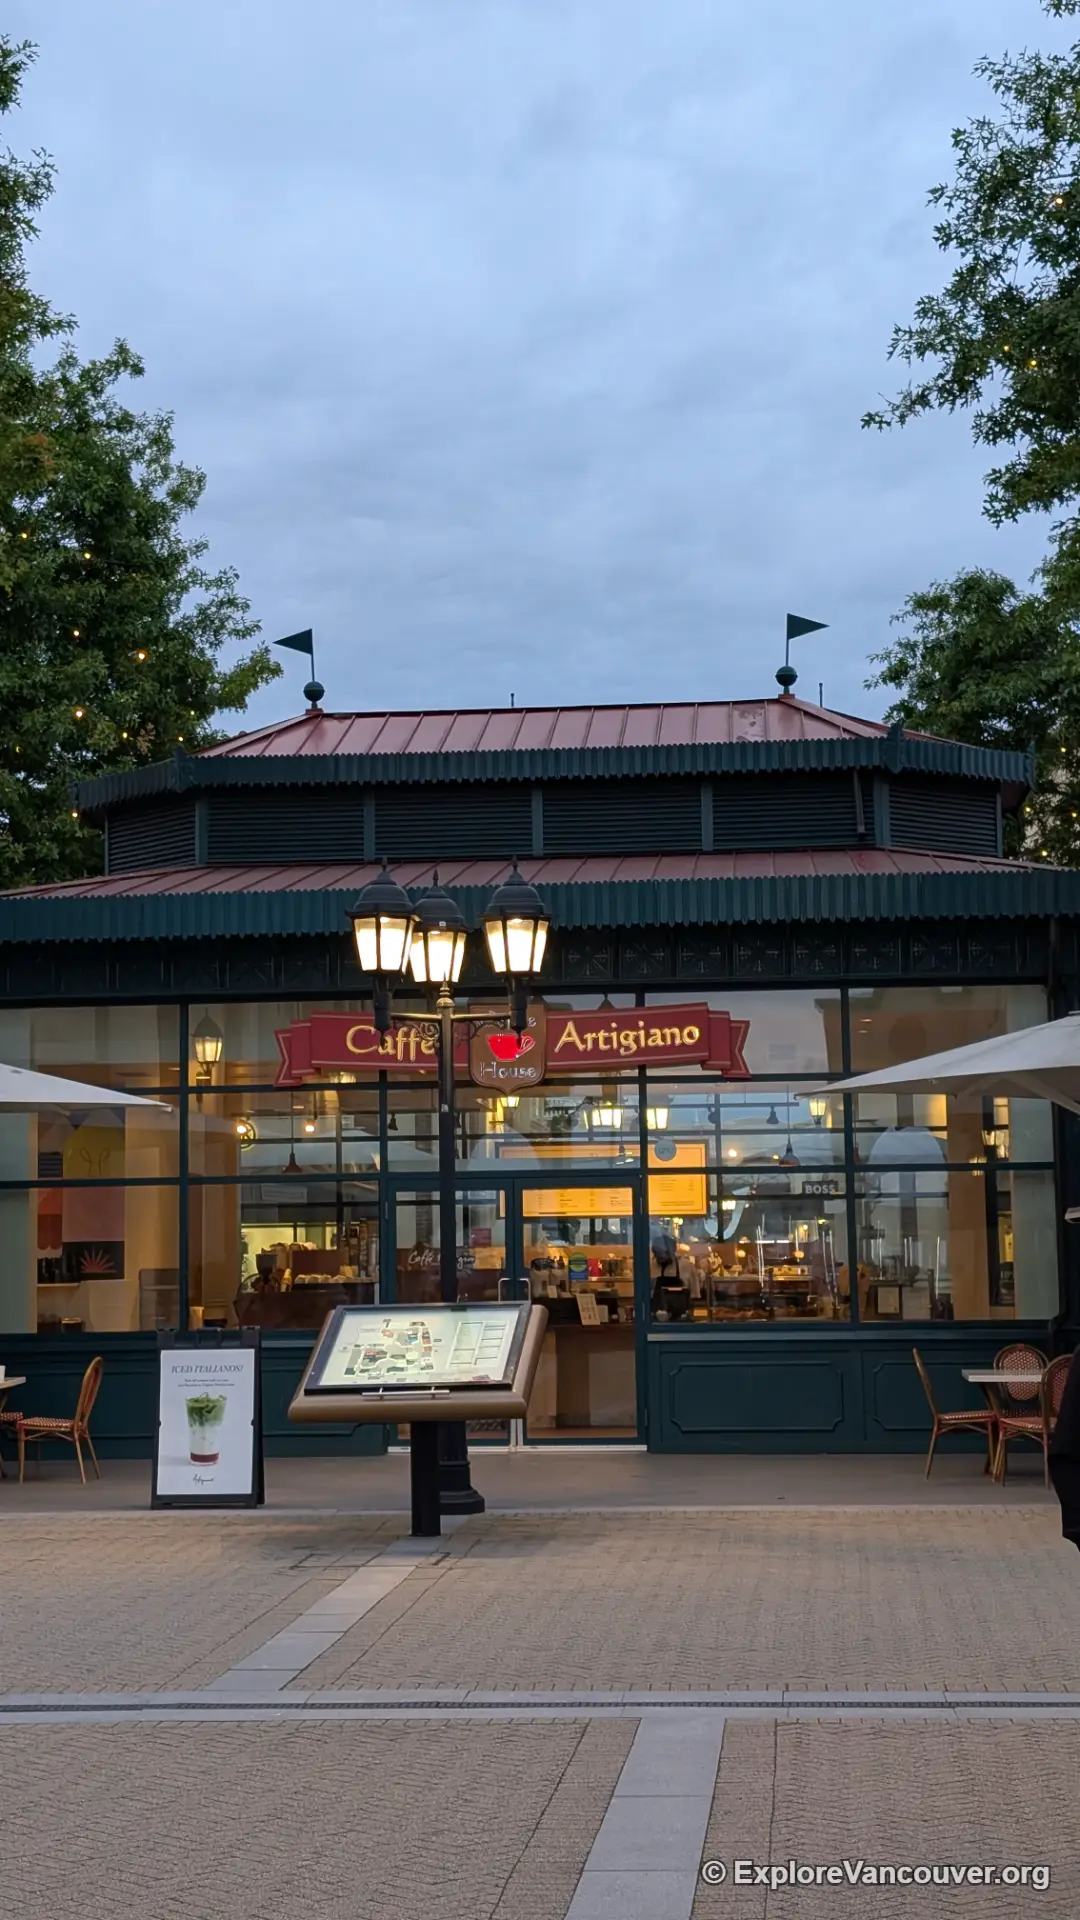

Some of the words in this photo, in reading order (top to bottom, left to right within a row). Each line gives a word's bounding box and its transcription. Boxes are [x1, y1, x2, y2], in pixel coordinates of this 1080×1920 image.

[554, 1020, 700, 1056] Artigiano
[480, 1061, 537, 1079] House
[805, 1184, 836, 1195] BOSS
[171, 1365, 193, 1374] ICED
